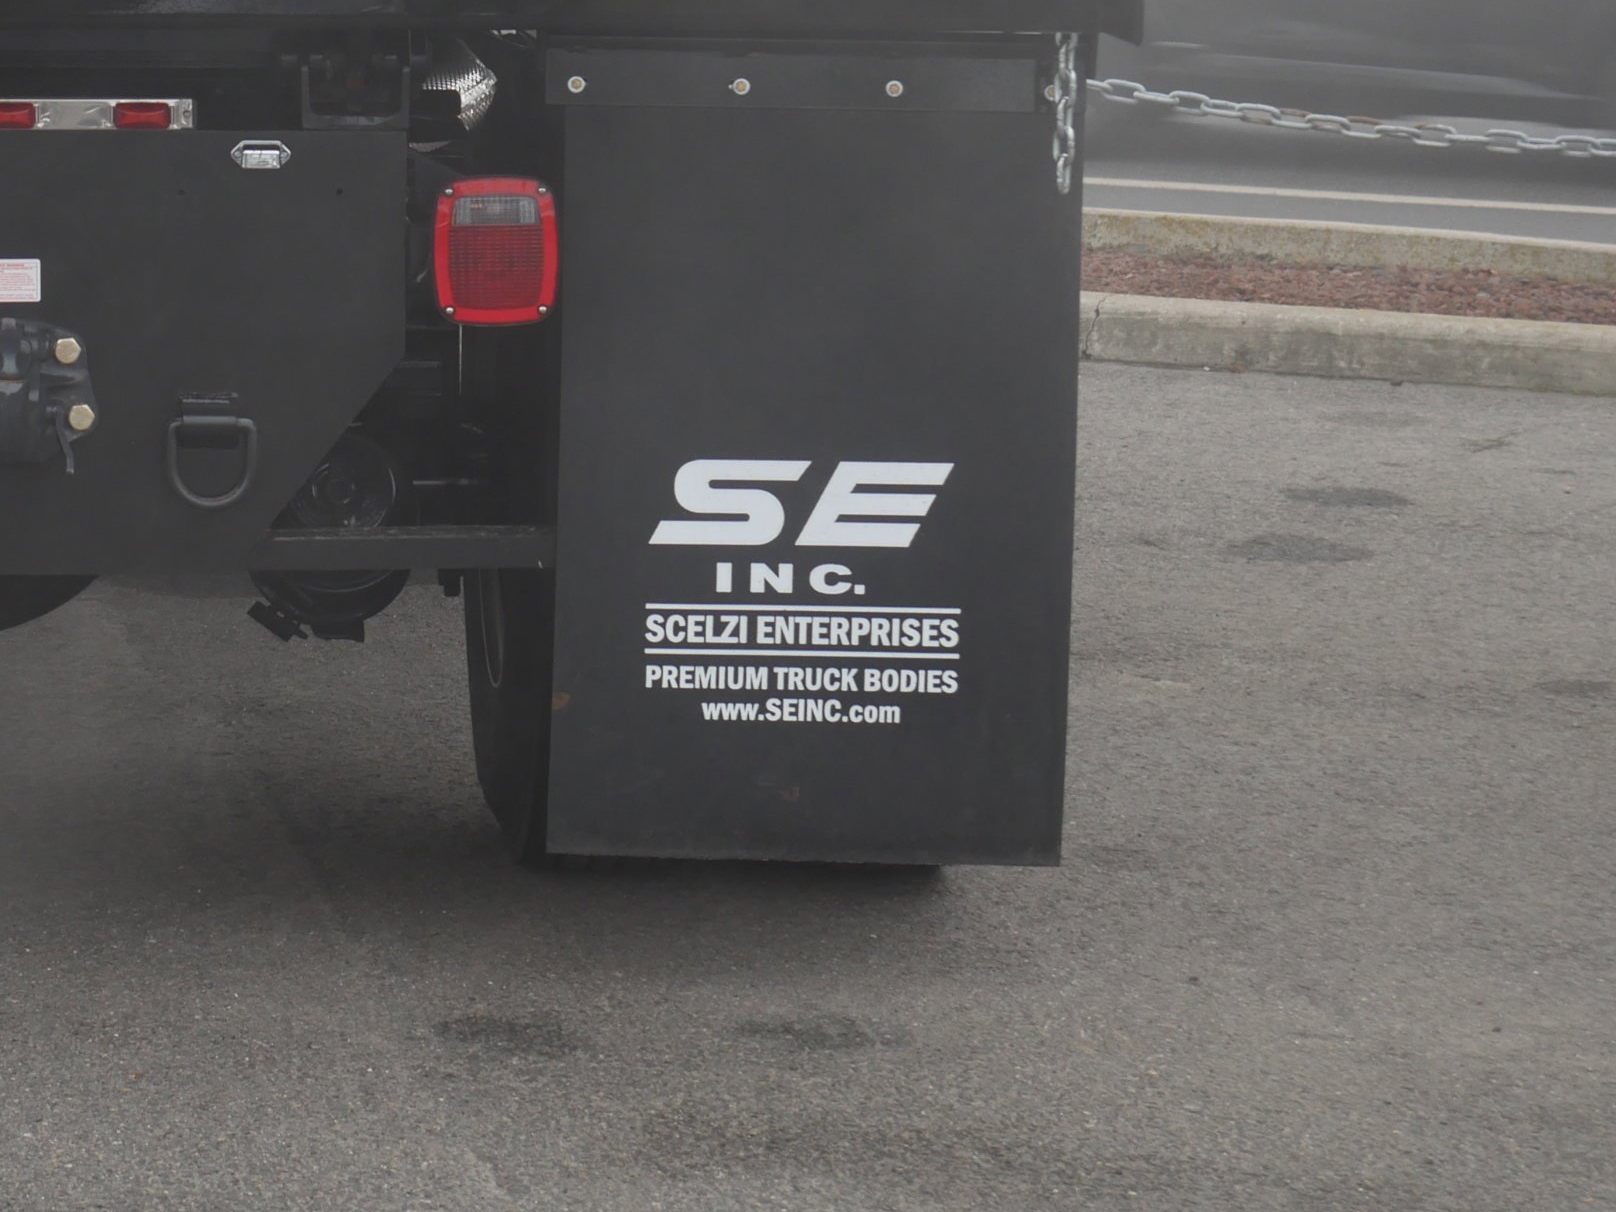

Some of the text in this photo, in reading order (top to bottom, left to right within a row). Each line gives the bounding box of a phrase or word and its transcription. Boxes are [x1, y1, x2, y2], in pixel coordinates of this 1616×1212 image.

[648, 458, 955, 548] SE
[716, 561, 865, 595] INC.
[644, 614, 960, 648] SCELZI ENTERPRISES
[645, 664, 959, 694] PREMIUM TRUCK BODIES
[701, 697, 901, 724] www.SEINC.com
